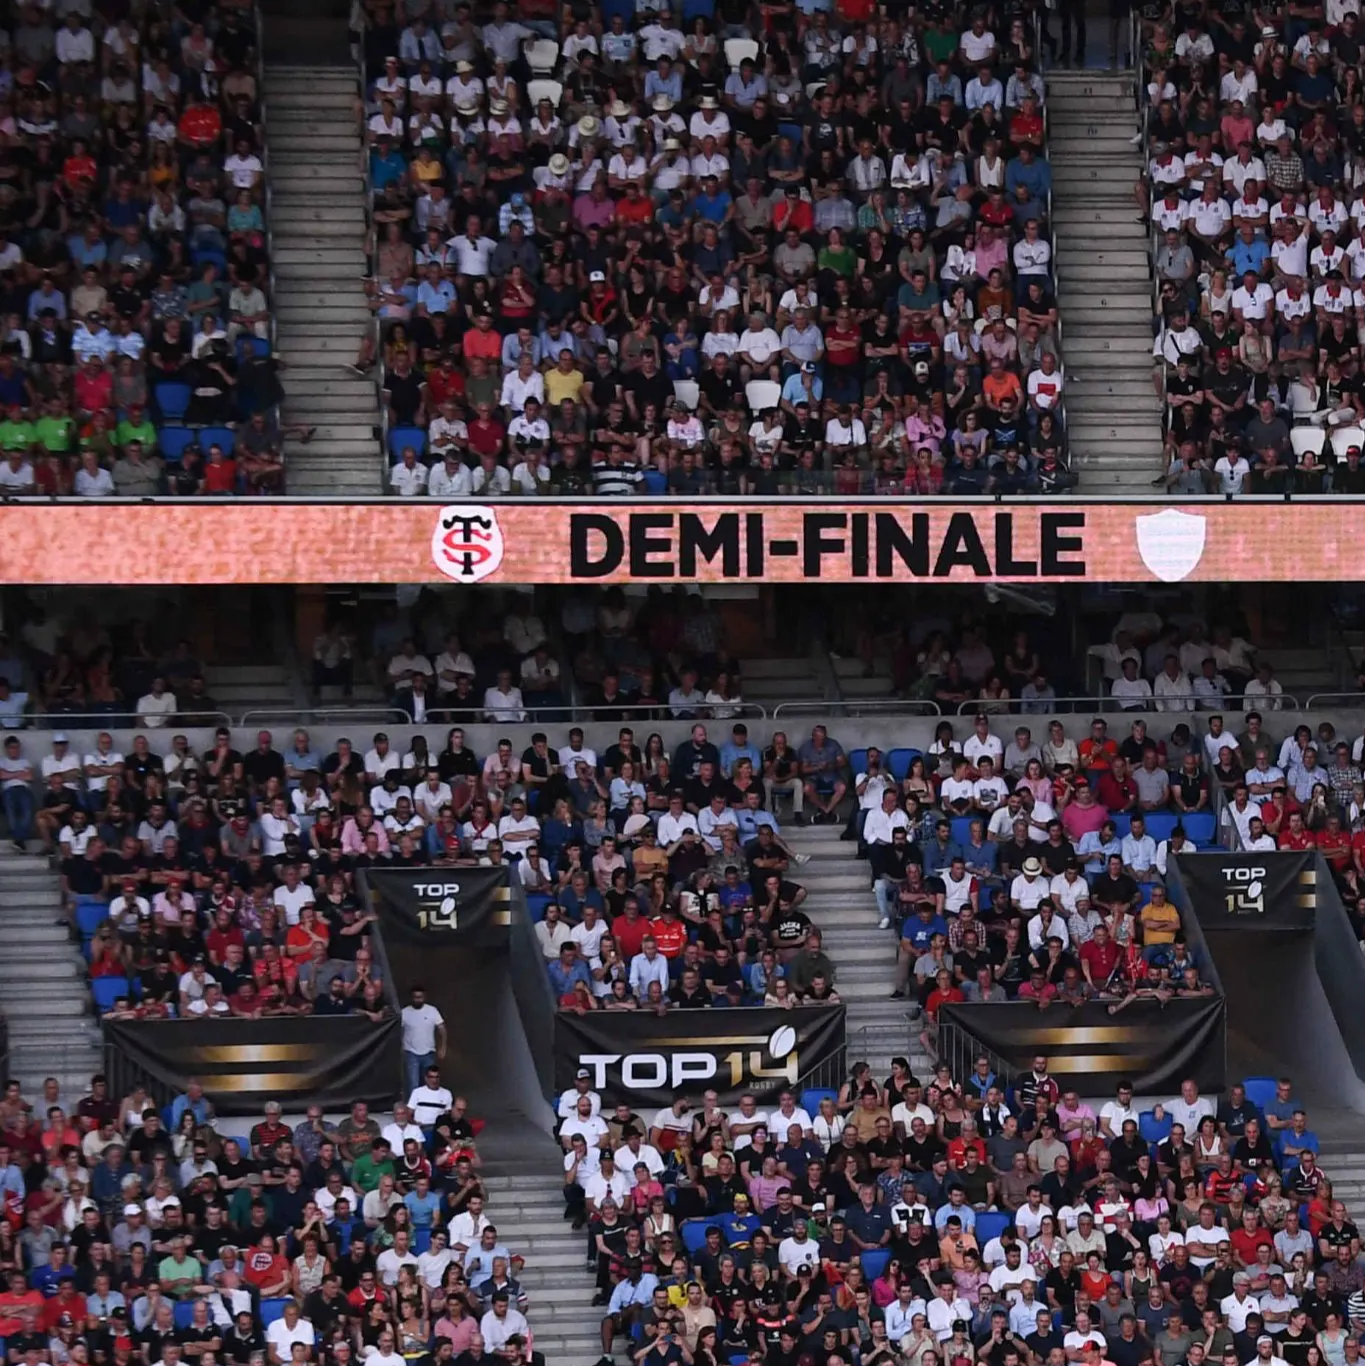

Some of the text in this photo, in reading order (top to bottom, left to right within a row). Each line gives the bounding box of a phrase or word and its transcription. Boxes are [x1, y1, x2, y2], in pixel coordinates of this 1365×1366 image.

[570, 512, 1087, 577] DEMI-FINALE
[1220, 868, 1265, 880] TOP
[413, 884, 460, 897] TOP
[1225, 894, 1264, 913] 14
[416, 911, 458, 930] 14
